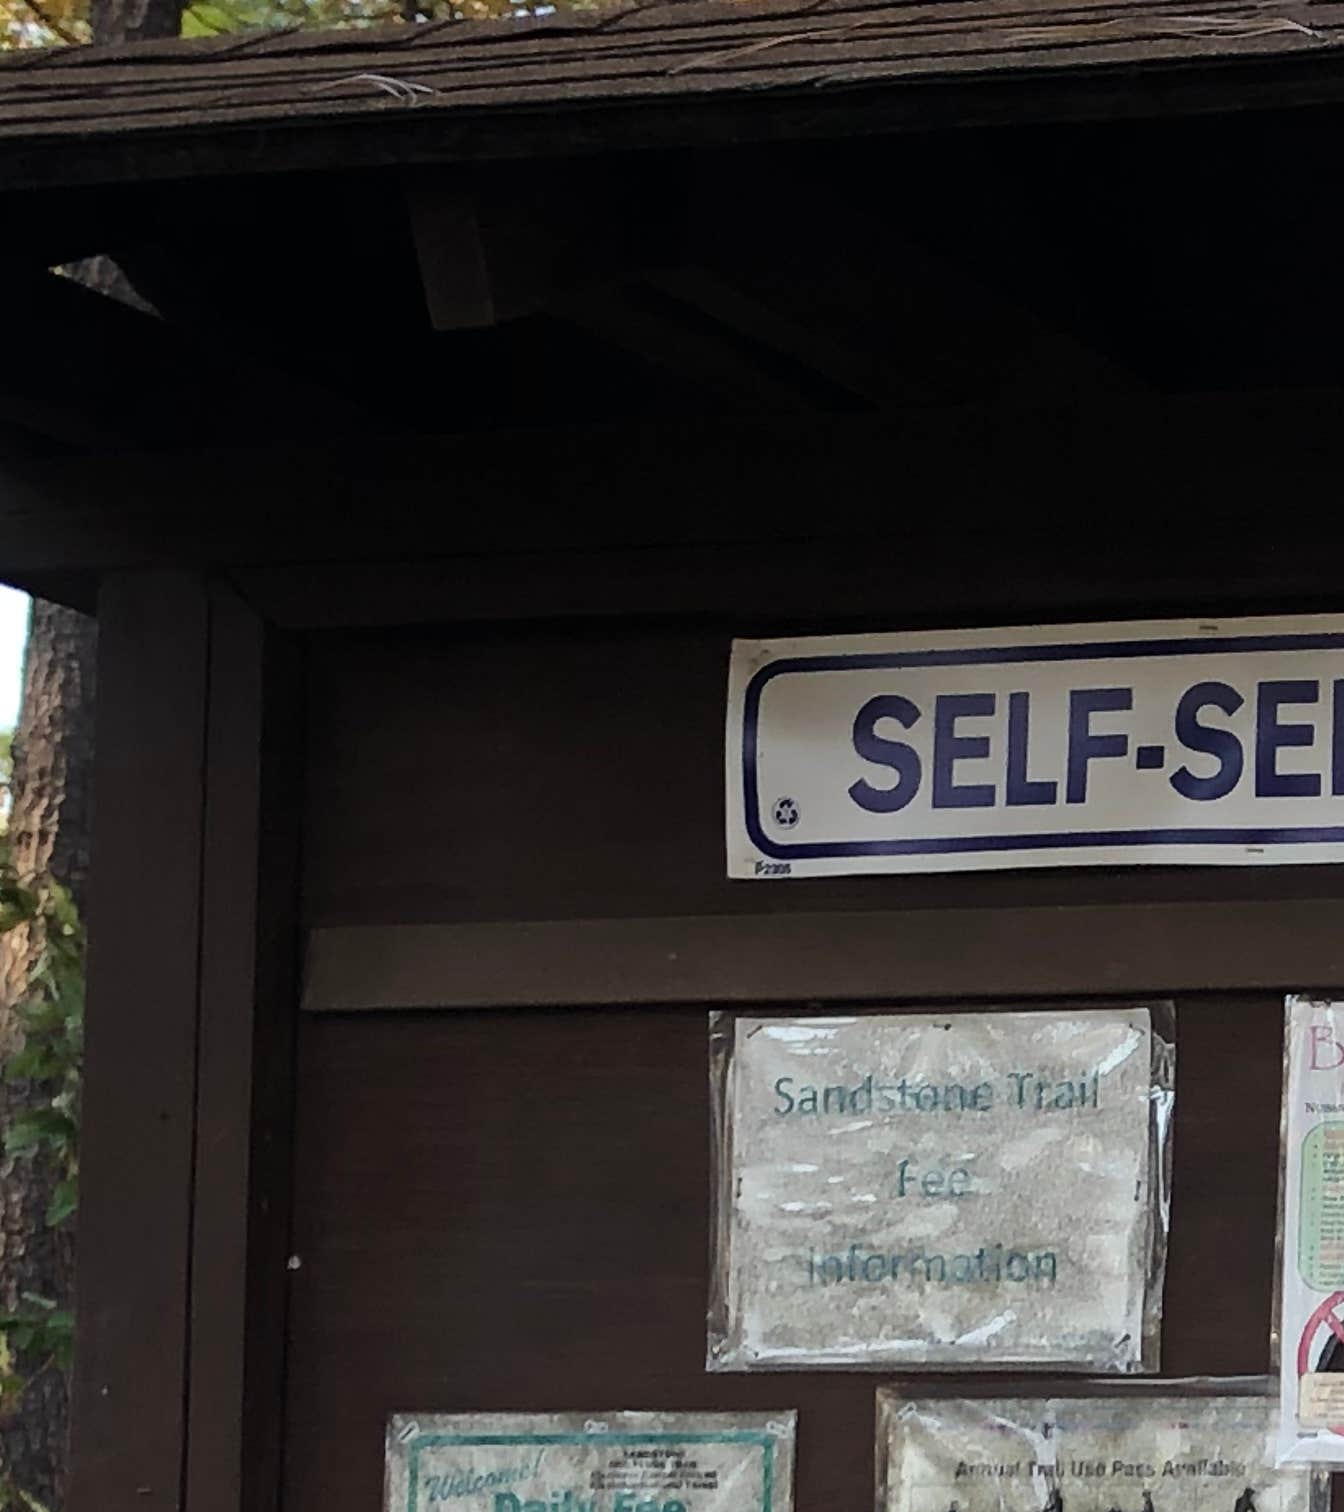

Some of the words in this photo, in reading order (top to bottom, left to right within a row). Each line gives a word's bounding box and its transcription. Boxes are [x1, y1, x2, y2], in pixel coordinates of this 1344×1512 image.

[773, 1074, 993, 1117] Sandstone
[1007, 1070, 1100, 1110] Trail
[896, 1158, 972, 1198] Fee
[1071, 1460, 1106, 1478] Use
